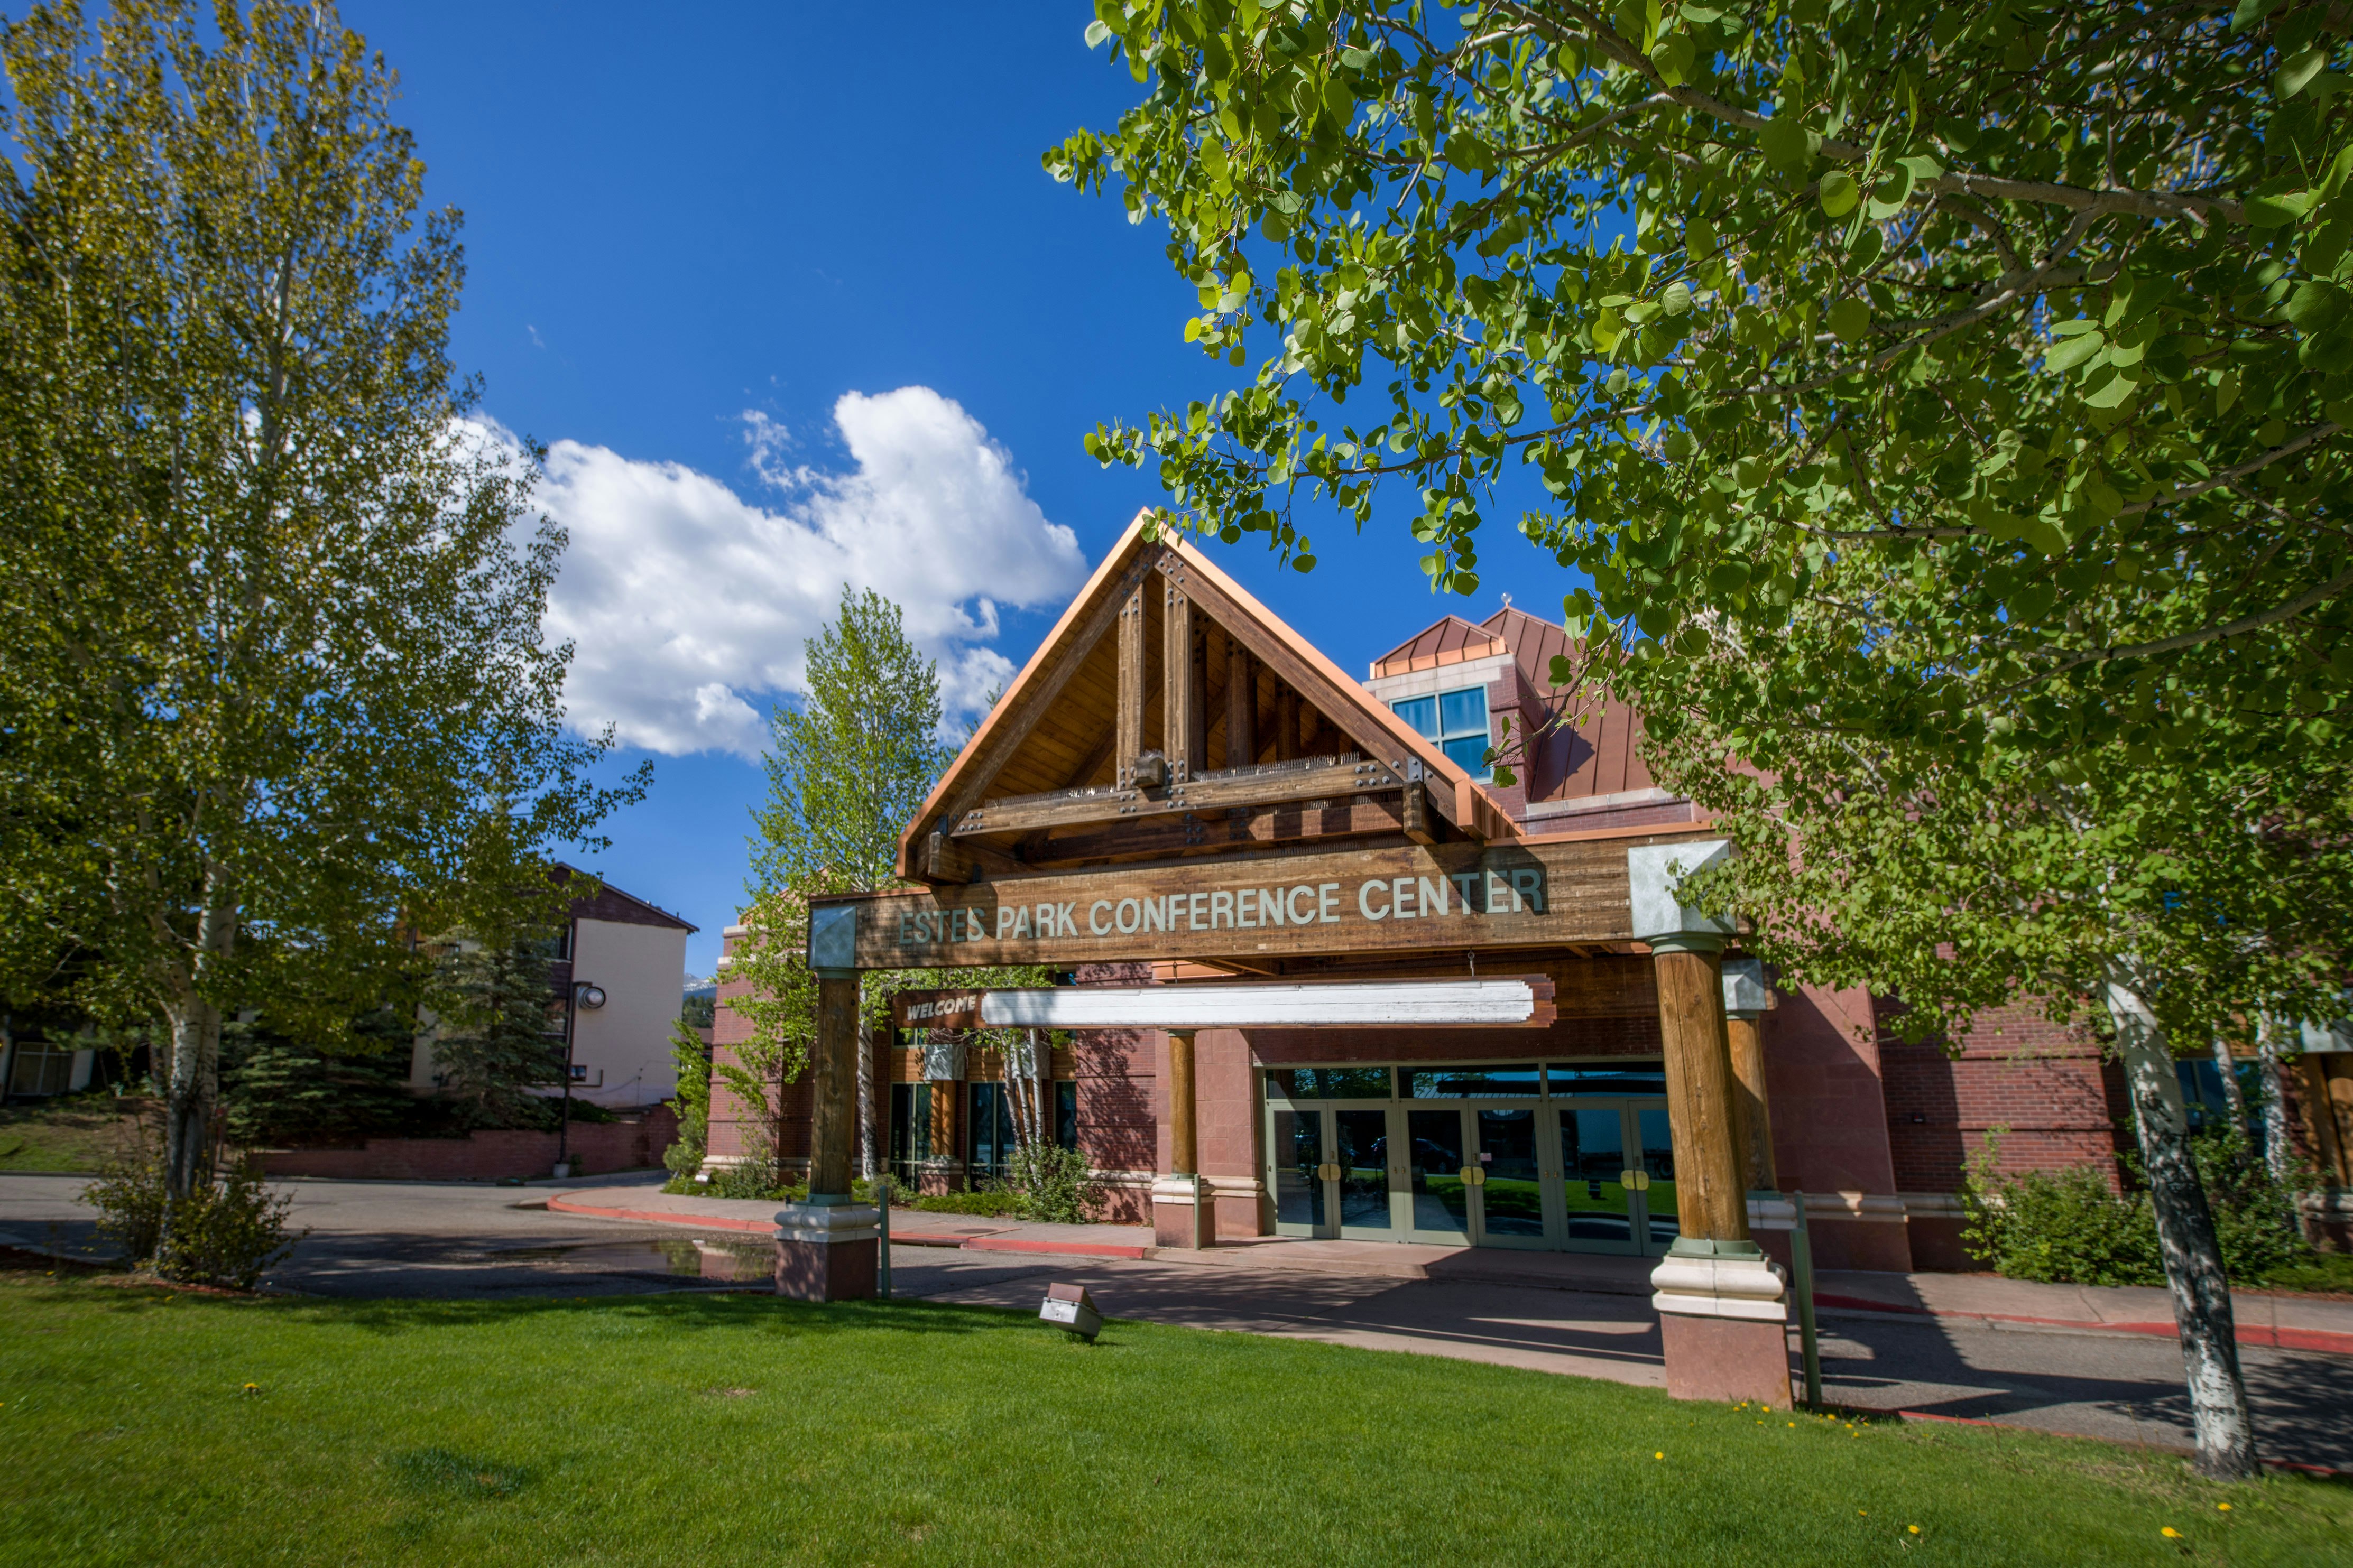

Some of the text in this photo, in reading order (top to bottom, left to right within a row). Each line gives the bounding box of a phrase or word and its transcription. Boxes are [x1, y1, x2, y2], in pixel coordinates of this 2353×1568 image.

[899, 869, 1543, 944] ESTES PARK CONFERENCE CENTER
[907, 994, 977, 1020] WELCOME
